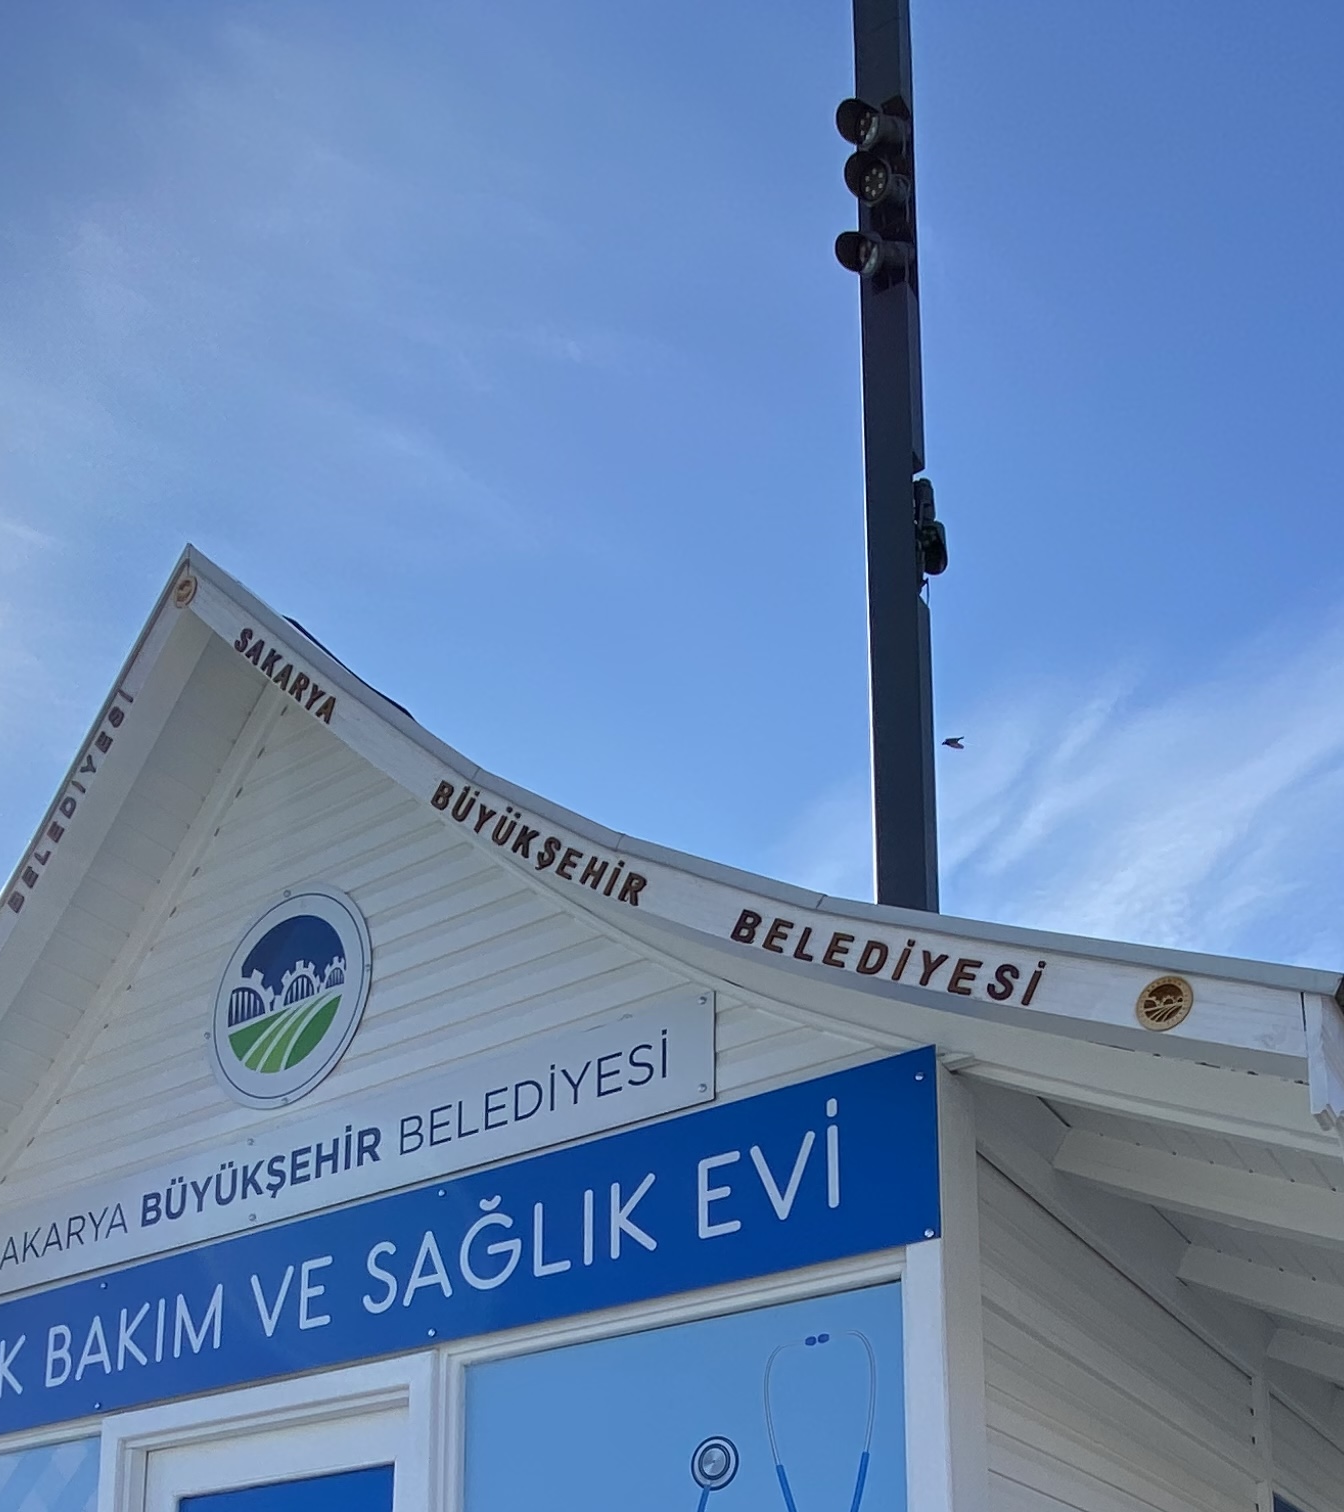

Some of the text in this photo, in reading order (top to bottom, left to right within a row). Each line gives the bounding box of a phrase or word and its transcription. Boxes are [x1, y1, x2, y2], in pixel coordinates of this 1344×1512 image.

[233, 627, 338, 725] SAKARYA
[429, 779, 649, 907] BÜYÜKŞEHİR
[729, 908, 1049, 1007] BELEDİYESİ
[44, 1283, 224, 1389] BAKIM
[250, 1255, 335, 1338] VE
[362, 1172, 658, 1315] SAĞLIK
[697, 1097, 840, 1241] EVİ
[140, 1125, 382, 1229] BÜYÜKŞEHİR
[399, 1028, 669, 1157] BELEDİYESİ
